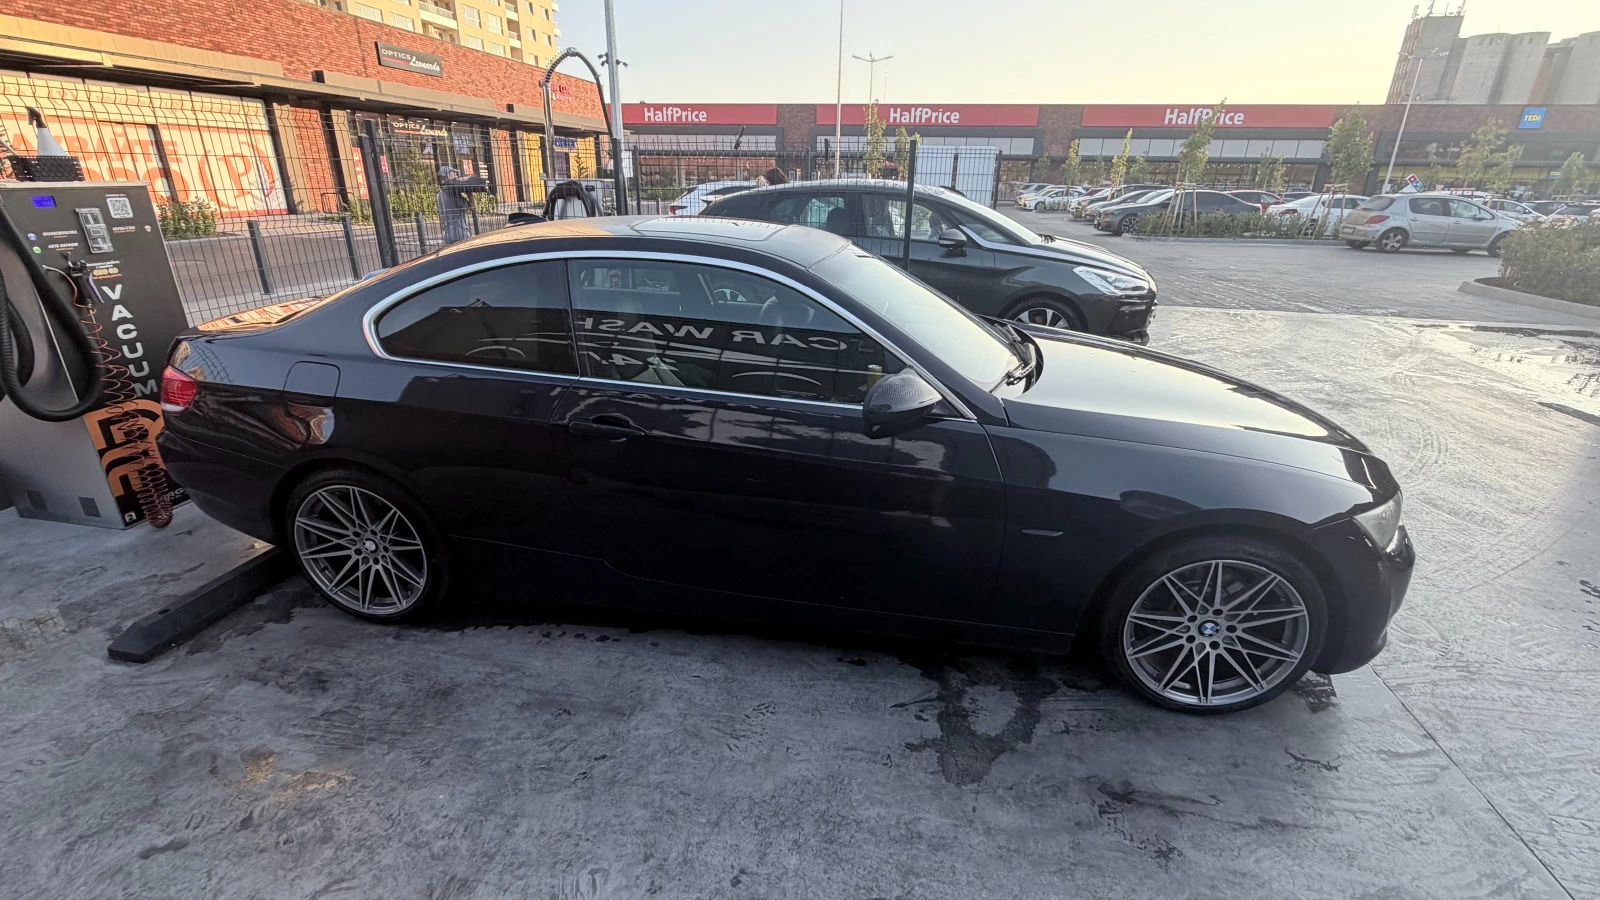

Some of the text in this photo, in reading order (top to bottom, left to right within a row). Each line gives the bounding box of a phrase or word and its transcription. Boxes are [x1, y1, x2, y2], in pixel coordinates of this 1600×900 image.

[381, 48, 441, 72] OPTICS Leonardo
[644, 106, 707, 122] HalfPrice
[889, 107, 960, 124] HalfPrice
[1164, 107, 1245, 125] HalfPrice
[393, 121, 421, 130] OPTICS
[353, 151, 367, 195] SALE
[101, 284, 158, 397] VACUUM
